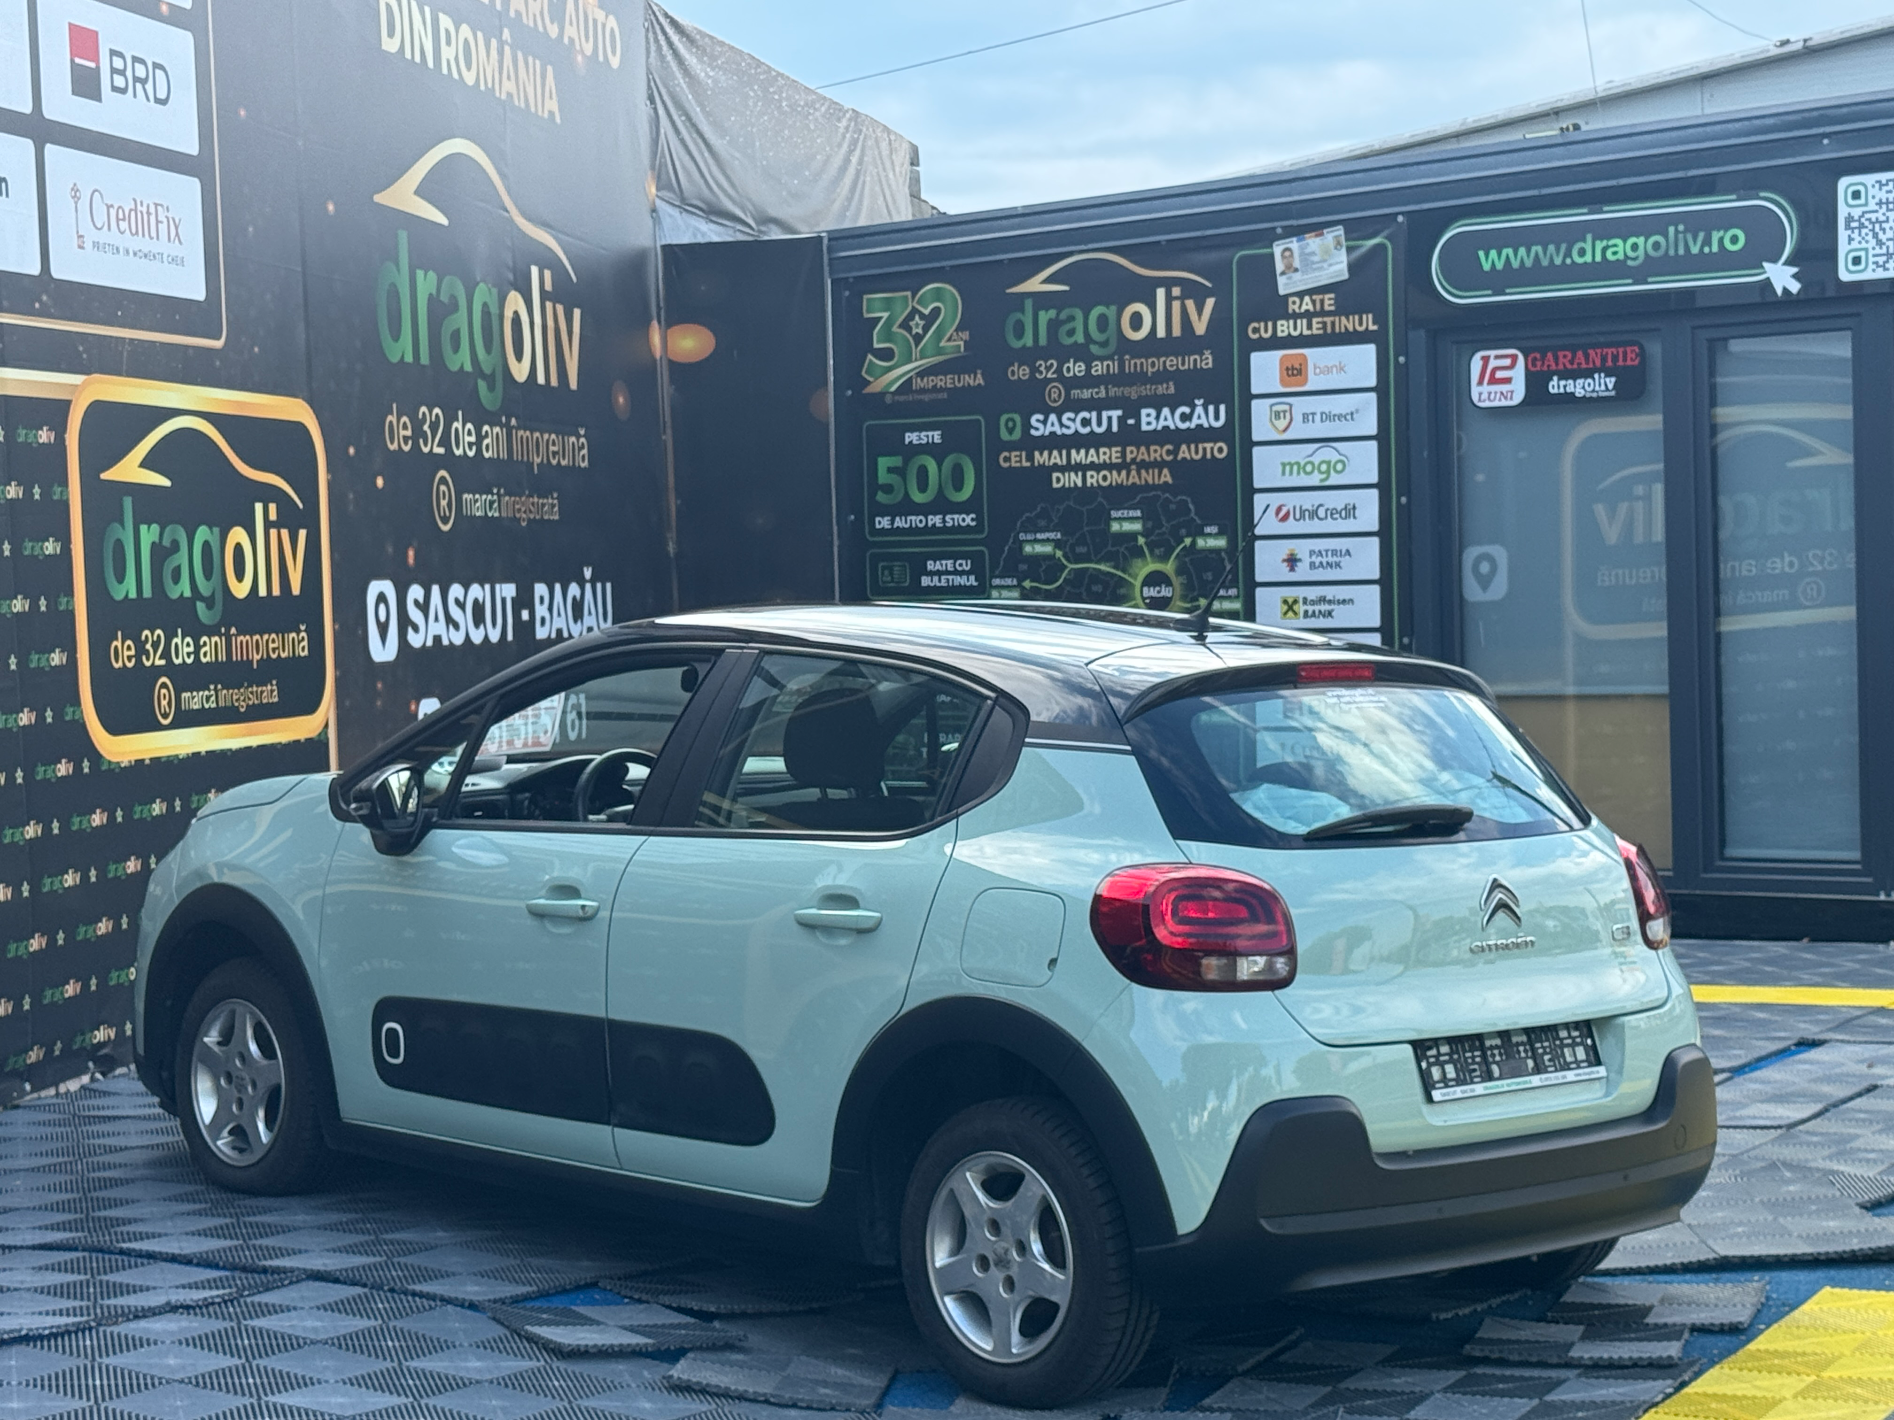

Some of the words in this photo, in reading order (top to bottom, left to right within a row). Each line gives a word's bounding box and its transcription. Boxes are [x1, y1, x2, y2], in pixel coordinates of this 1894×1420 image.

[563, 0, 621, 69] AUTO
[379, 0, 434, 69] DIN
[438, 12, 561, 124] ROMÂNIA
[109, 48, 172, 106] BRD
[89, 188, 183, 246] CreditFix
[1477, 224, 1746, 272] www.dragoliv.ro
[1288, 293, 1335, 314] RATE
[375, 230, 581, 411] dragoliv
[1005, 286, 1215, 356] dragoliv
[1248, 321, 1272, 339] CU
[1276, 313, 1378, 337] BULETINUL
[951, 330, 970, 342] ANI
[1008, 362, 1029, 380] de
[1035, 361, 1057, 379] 32
[1063, 358, 1086, 377] de
[1091, 355, 1118, 376] ani
[1123, 350, 1214, 377] împreună
[1284, 363, 1302, 377] tbi
[1313, 361, 1347, 376] bank
[1476, 352, 1519, 387] 12
[1527, 345, 1640, 372] GARANTIE
[912, 369, 985, 390] ÎMPREUNĂ
[1071, 386, 1105, 400] marcă
[1108, 381, 1175, 402] înregistrată
[1476, 389, 1514, 404] LUNI
[1548, 372, 1617, 398] dragoliv
[1030, 409, 1122, 437] SASCUT
[1141, 399, 1226, 432] BACĂU
[1273, 409, 1288, 421] BT
[1302, 411, 1317, 424] BT
[16, 425, 55, 446] dragoliv
[385, 403, 412, 451] de
[419, 406, 445, 455] 32
[451, 410, 476, 457] de
[482, 417, 507, 461] ani
[511, 417, 589, 474] împreună
[905, 430, 942, 445] PESTE
[999, 451, 1031, 468] CEL
[1034, 450, 1066, 467] MAI
[1071, 447, 1122, 465] MARE
[1126, 445, 1174, 463] PARC
[1177, 442, 1228, 460] AUTO
[875, 453, 975, 505] 500
[1052, 472, 1083, 489] DIN
[1086, 466, 1173, 488] ROMÂNIA
[1280, 458, 1347, 483] mogo
[462, 488, 499, 518] marcă
[1292, 503, 1357, 522] UniCredit
[875, 516, 891, 529] DE
[893, 515, 926, 528] AUTO
[928, 515, 944, 527] PE
[945, 514, 977, 527] STOC
[22, 537, 61, 559] dragoliv
[103, 496, 307, 625] dragoliv
[1309, 548, 1352, 559] PATRIA
[927, 560, 954, 572] RATE
[955, 559, 971, 571] CU
[1309, 560, 1343, 571] BANK
[921, 575, 978, 587] BULETINUL
[1142, 584, 1173, 598] BACĂU
[406, 583, 516, 649] SASCUT
[534, 566, 613, 640] BACĂU
[1302, 596, 1354, 607] Raiffeisen
[1302, 608, 1335, 619] BANK
[110, 631, 135, 669] de
[141, 629, 166, 666] 32
[171, 628, 195, 664] de
[200, 627, 226, 663] ani
[230, 624, 309, 669] împreună
[28, 648, 67, 671] dragoliv
[181, 685, 216, 711] marcă
[217, 679, 279, 712] înregistrată
[35, 758, 74, 782] dragoliv
[2, 820, 43, 845] dragoliv
[70, 808, 108, 832] dragoliv
[41, 868, 81, 894] dragoliv
